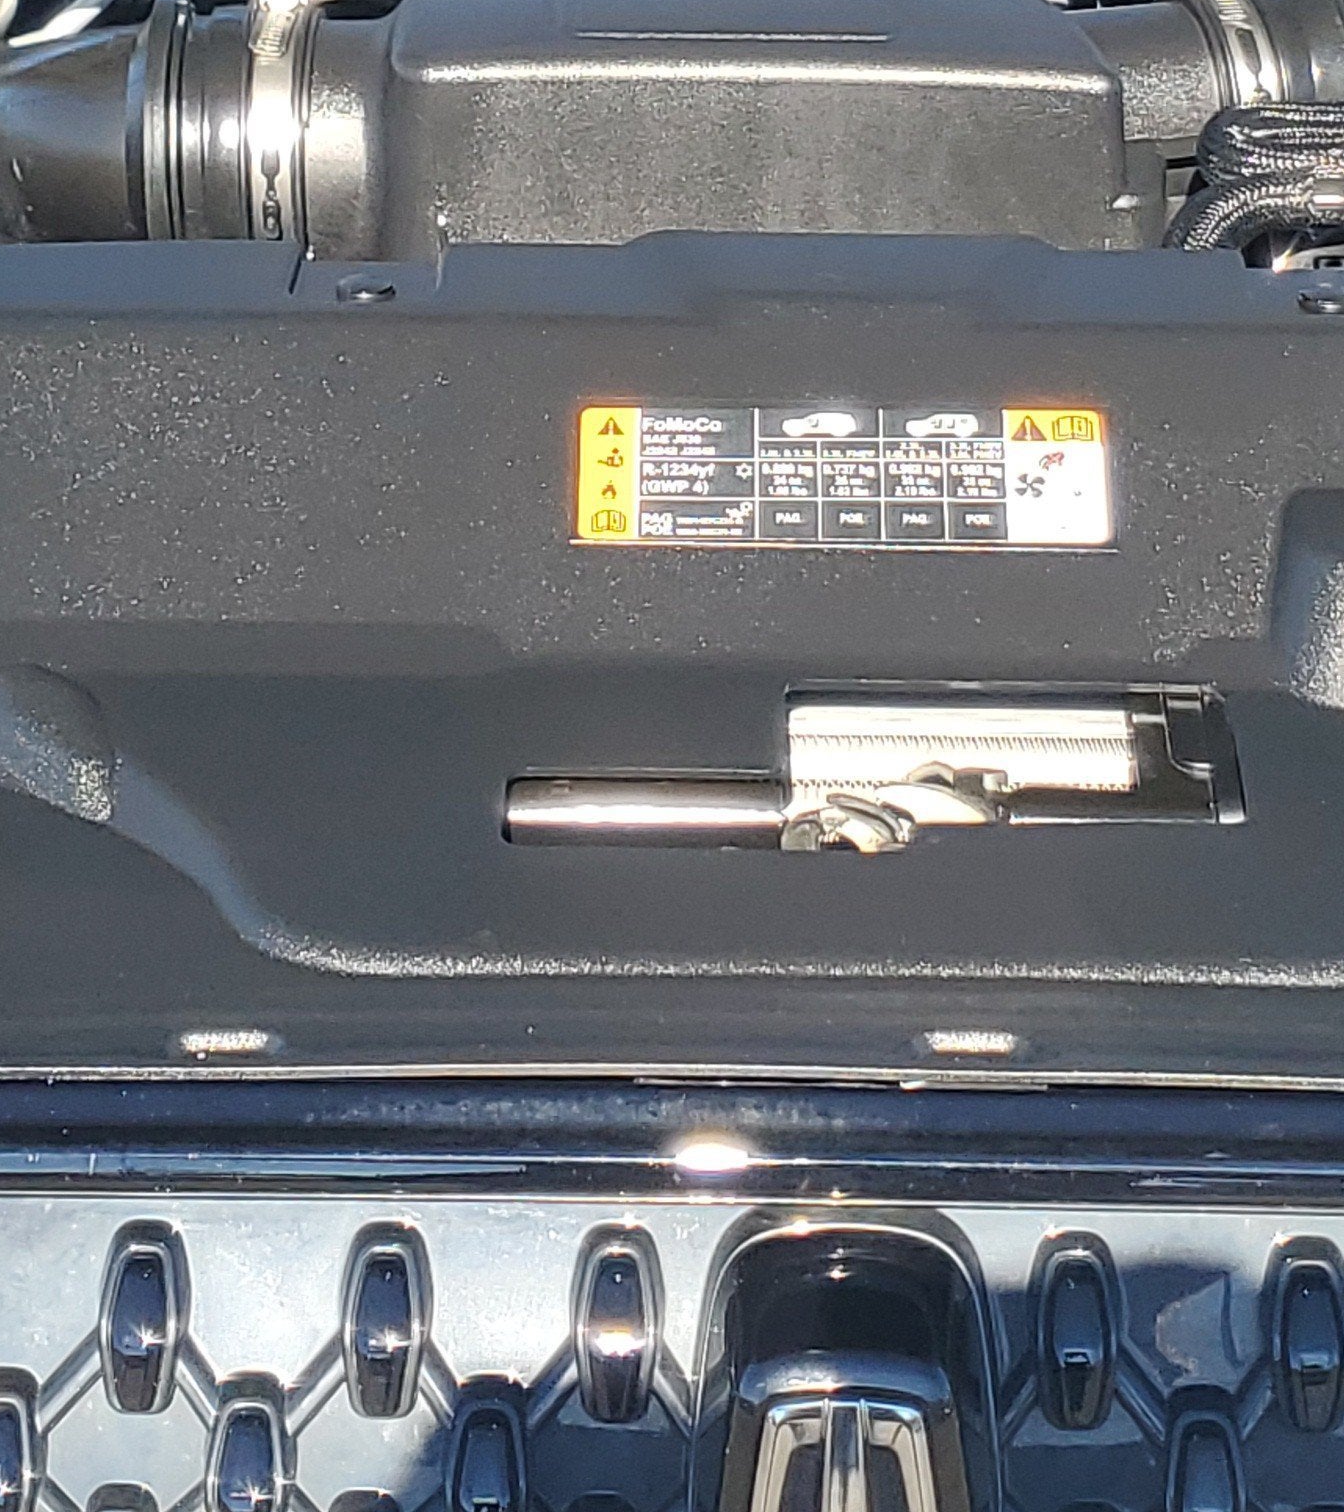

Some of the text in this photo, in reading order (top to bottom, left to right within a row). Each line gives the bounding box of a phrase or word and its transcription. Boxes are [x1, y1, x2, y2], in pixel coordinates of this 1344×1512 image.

[642, 417, 722, 432] FoMoCo
[642, 462, 716, 479] R-1234yf
[641, 479, 709, 495] (GWP 4)
[641, 512, 673, 524] PAG
[775, 512, 801, 524] PAG
[902, 513, 927, 525] PAG
